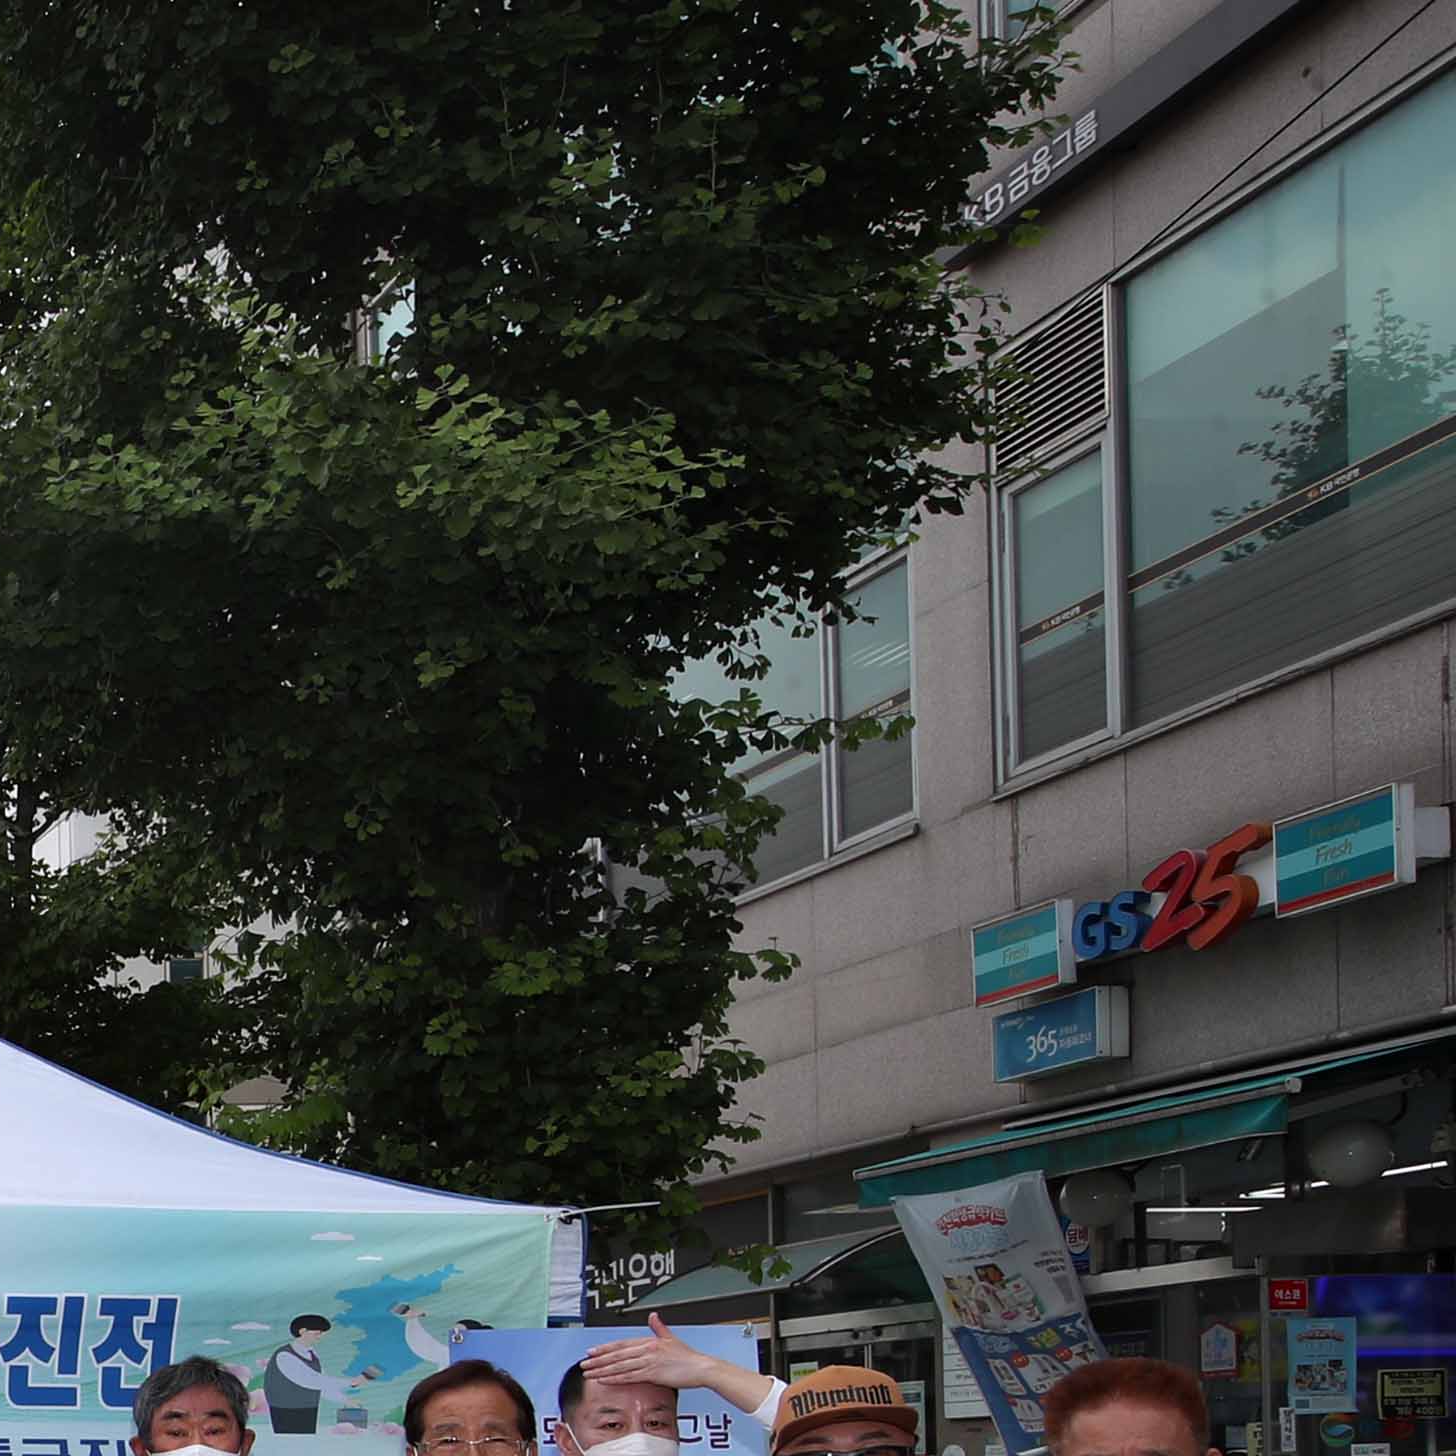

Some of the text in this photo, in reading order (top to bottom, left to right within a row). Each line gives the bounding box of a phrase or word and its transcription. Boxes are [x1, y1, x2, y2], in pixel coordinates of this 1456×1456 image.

[1314, 837, 1353, 865] Fresh
[1071, 823, 1272, 960] GS25
[1025, 1025, 1057, 1063] 365
